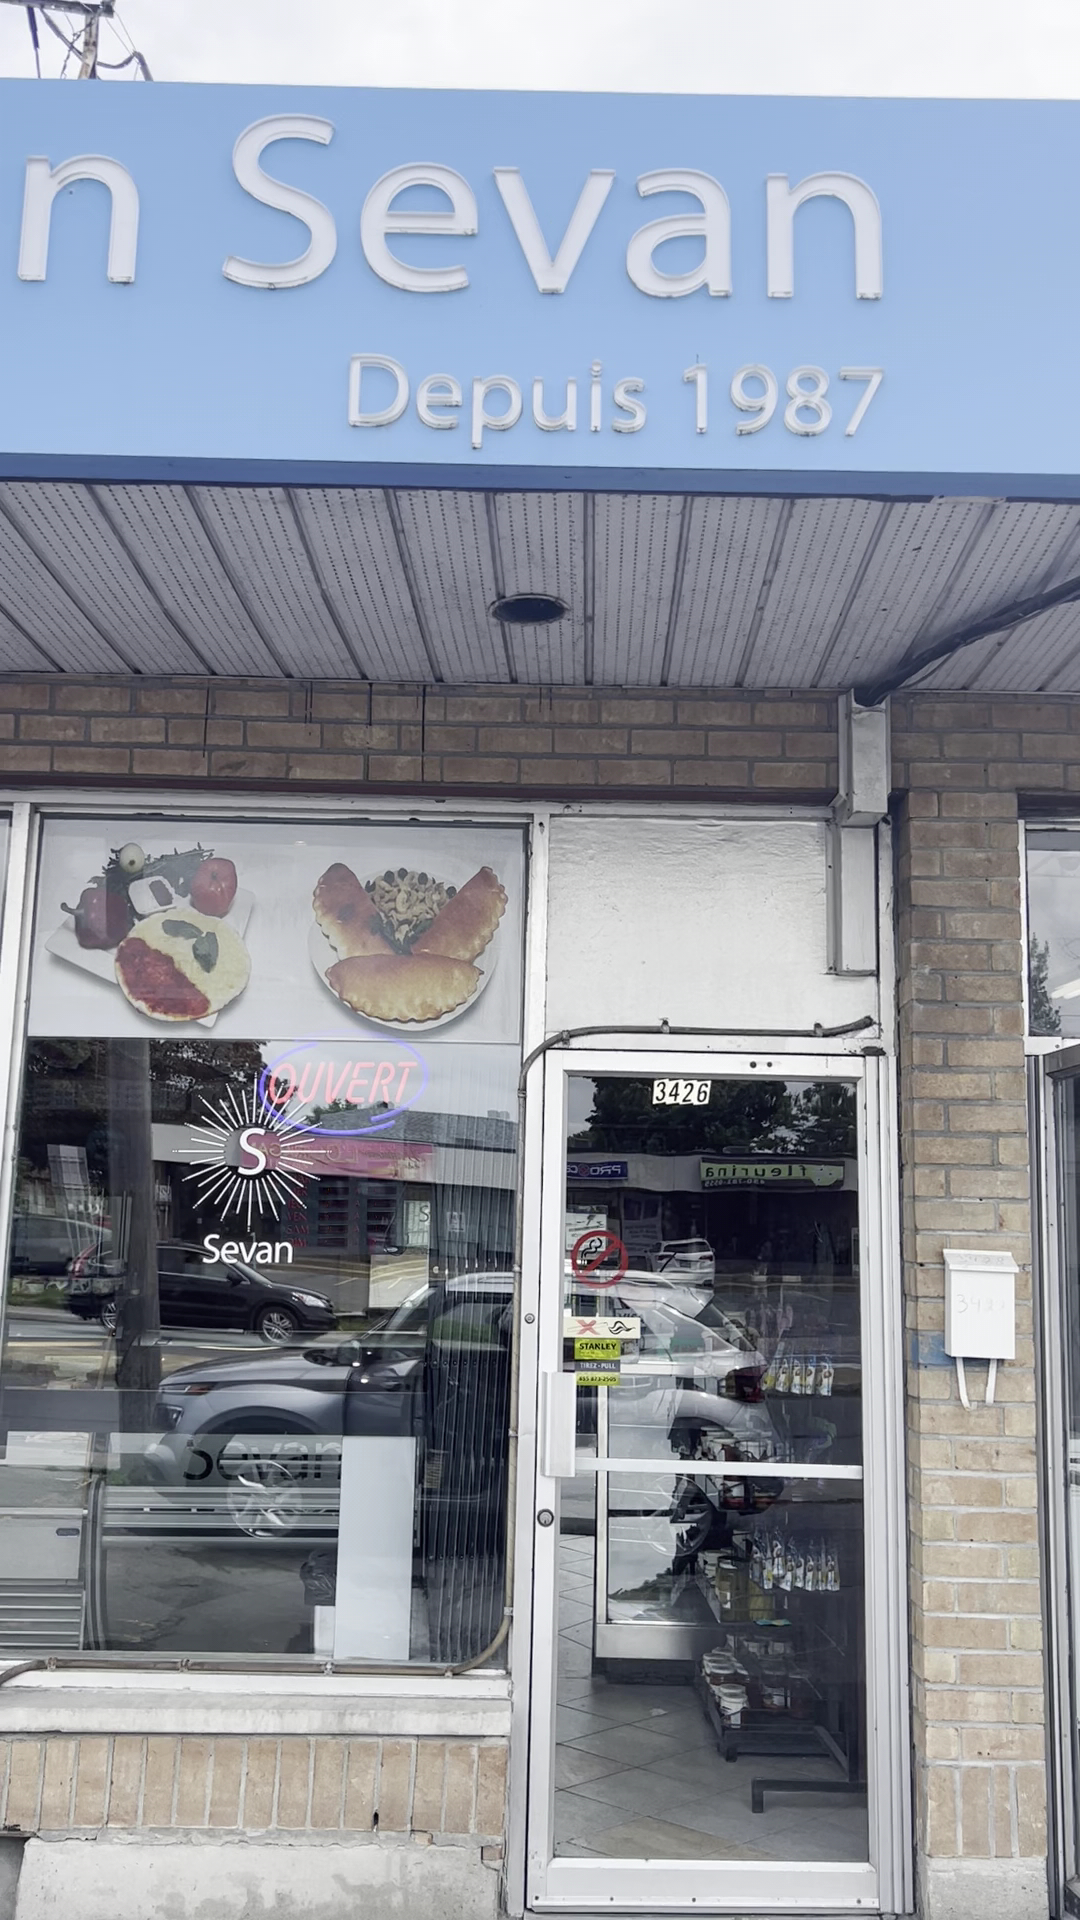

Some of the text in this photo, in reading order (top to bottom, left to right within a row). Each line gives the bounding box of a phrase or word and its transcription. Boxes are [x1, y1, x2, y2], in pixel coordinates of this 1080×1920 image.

[17, 113, 885, 300] n Sevan
[347, 352, 885, 450] Depuis 1987
[267, 1060, 419, 1106] OUVERT
[656, 1081, 709, 1103] 3426
[237, 1128, 268, 1177] S
[202, 1234, 294, 1265] Sevan
[579, 1342, 617, 1350] STANLEY
